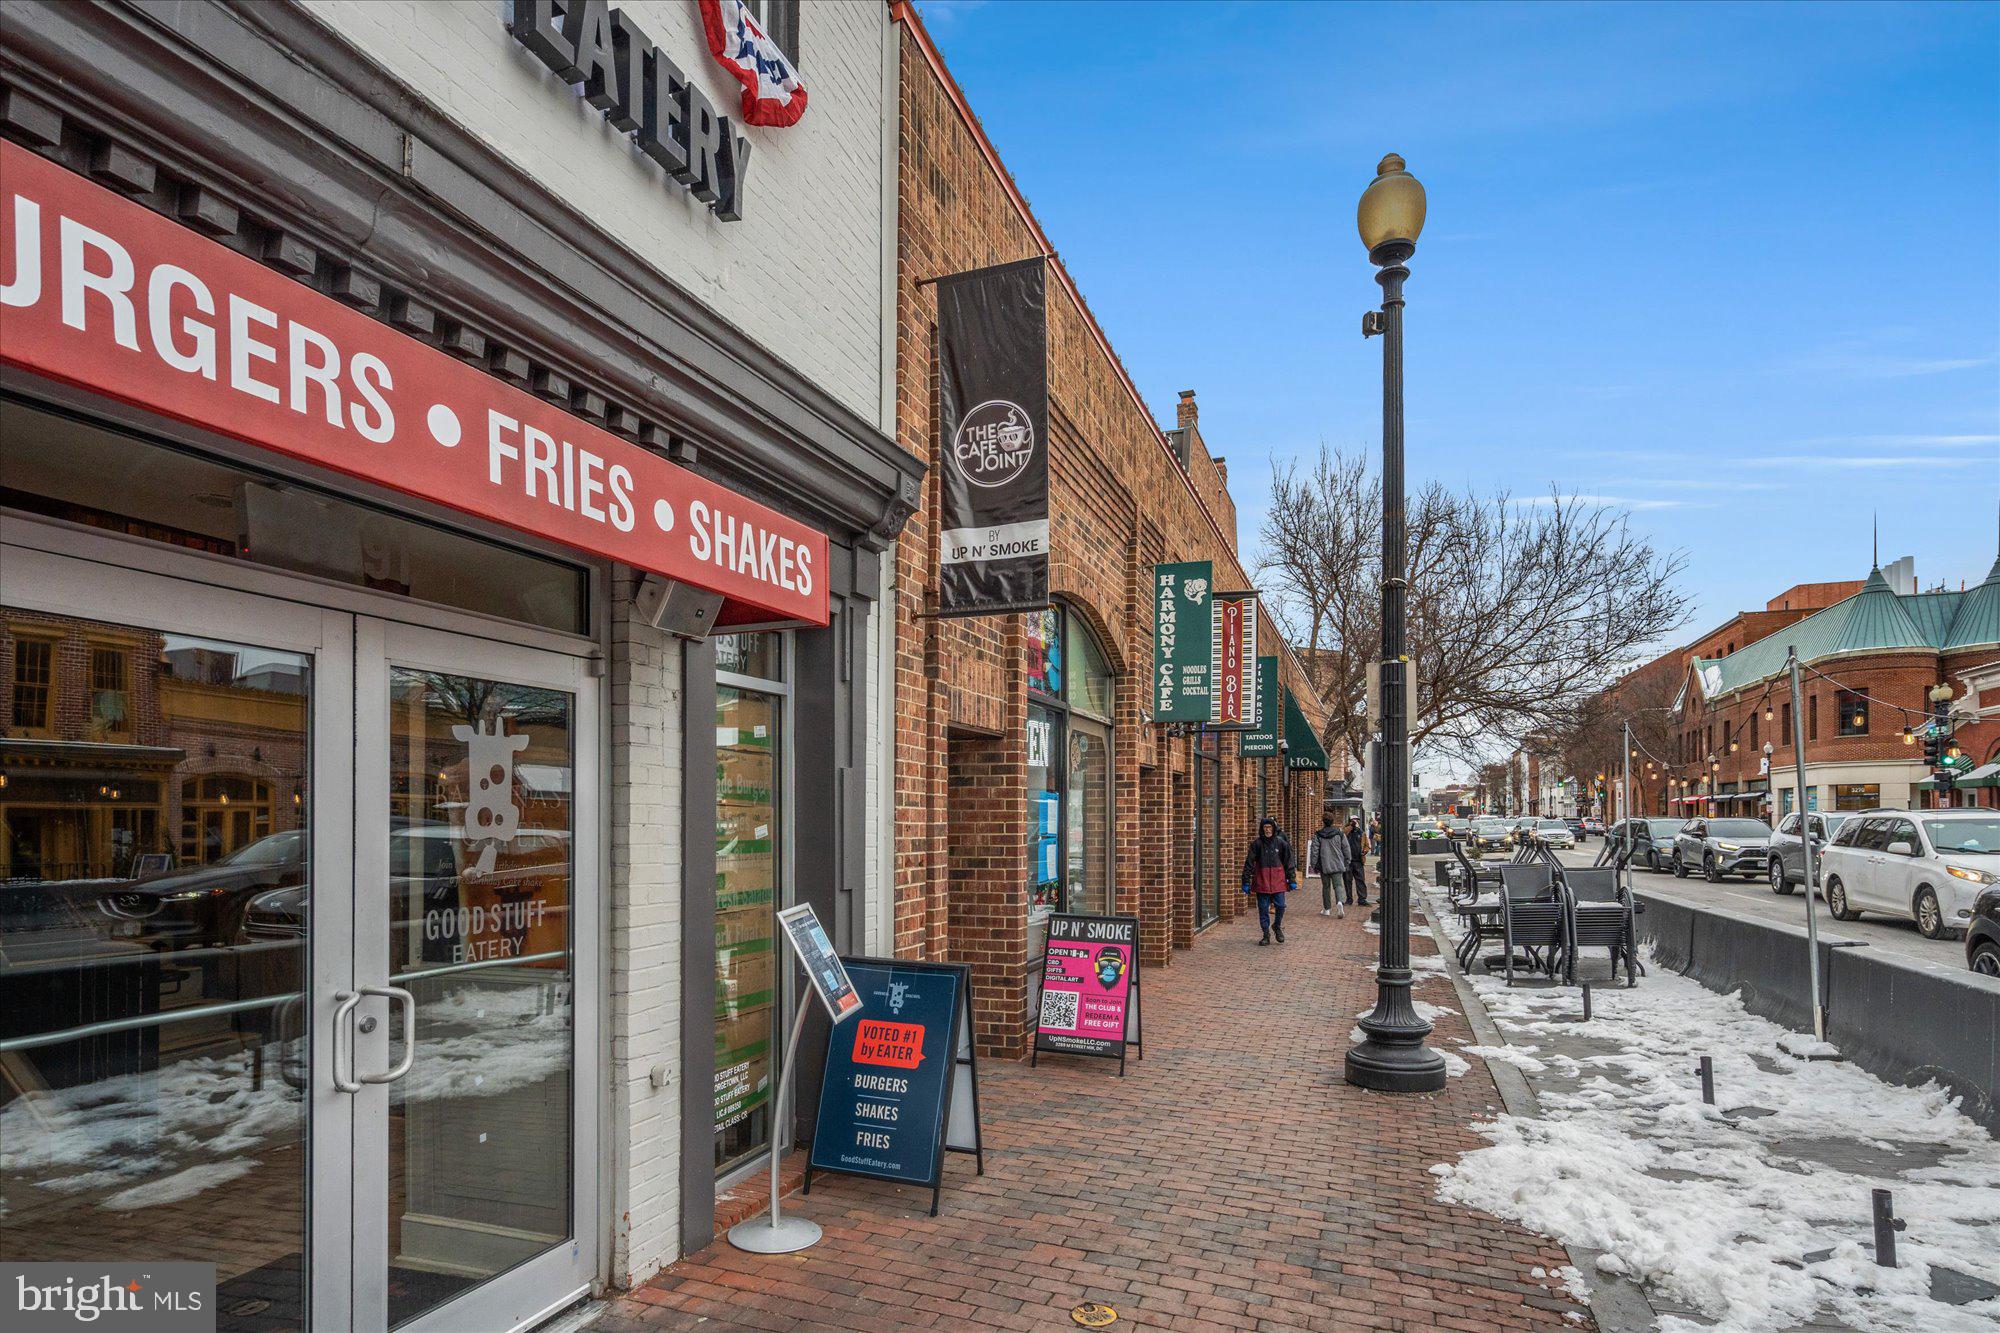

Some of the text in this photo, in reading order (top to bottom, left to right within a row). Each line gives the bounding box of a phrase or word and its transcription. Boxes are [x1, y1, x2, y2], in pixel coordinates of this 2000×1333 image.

[966, 423, 997, 442] THE
[956, 439, 998, 460] CAFE
[975, 449, 1031, 473] JOINT
[488, 408, 636, 534] FRIES
[688, 499, 814, 597] SHAKES
[988, 529, 1000, 542] BY
[952, 539, 1039, 559] UP N' SMOKE
[1159, 574, 1176, 711] HARMONY CAFE
[1182, 665, 1207, 675] NOODLES
[1226, 606, 1238, 718] PIANO BAR
[1182, 675, 1201, 685] GRILLS
[1182, 686, 1209, 696] COCKTAIL
[426, 900, 547, 940] GOOD STUFF
[1051, 920, 1132, 941] UP N' SMOKE
[453, 936, 524, 964] EATERY
[1048, 948, 1068, 956] OPEN
[1045, 974, 1067, 982] DIGITAL
[1085, 1011, 1113, 1020] REDEEM
[1098, 1004, 1116, 1012] CLUB
[1102, 1020, 1119, 1028] GIFT
[863, 1025, 917, 1044] VOTED #1
[860, 1043, 914, 1061] by EATER
[854, 1073, 909, 1093] BURGERS
[855, 1103, 899, 1121] SHAKES
[856, 1131, 890, 1149] FRIES
[841, 1154, 901, 1170] GoodStuffEatery.com
